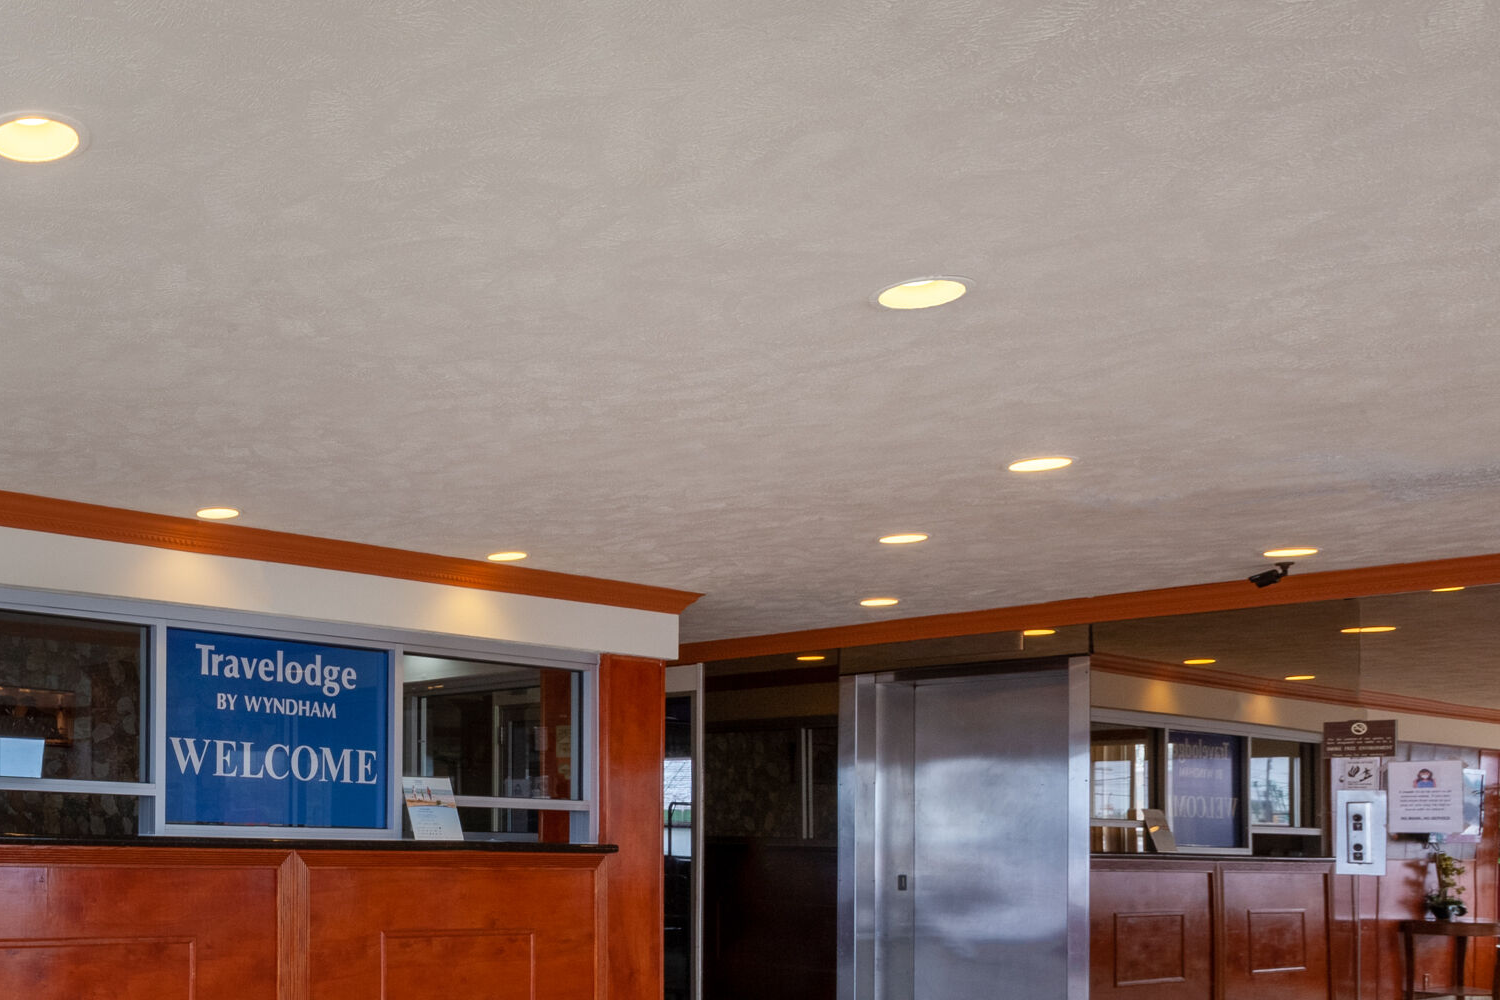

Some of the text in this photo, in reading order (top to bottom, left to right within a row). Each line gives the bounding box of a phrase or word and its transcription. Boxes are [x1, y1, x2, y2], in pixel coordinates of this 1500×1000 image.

[195, 643, 358, 697] Travelodge
[216, 693, 337, 719] BY WYNDHAM
[169, 736, 378, 785] WELCOME
